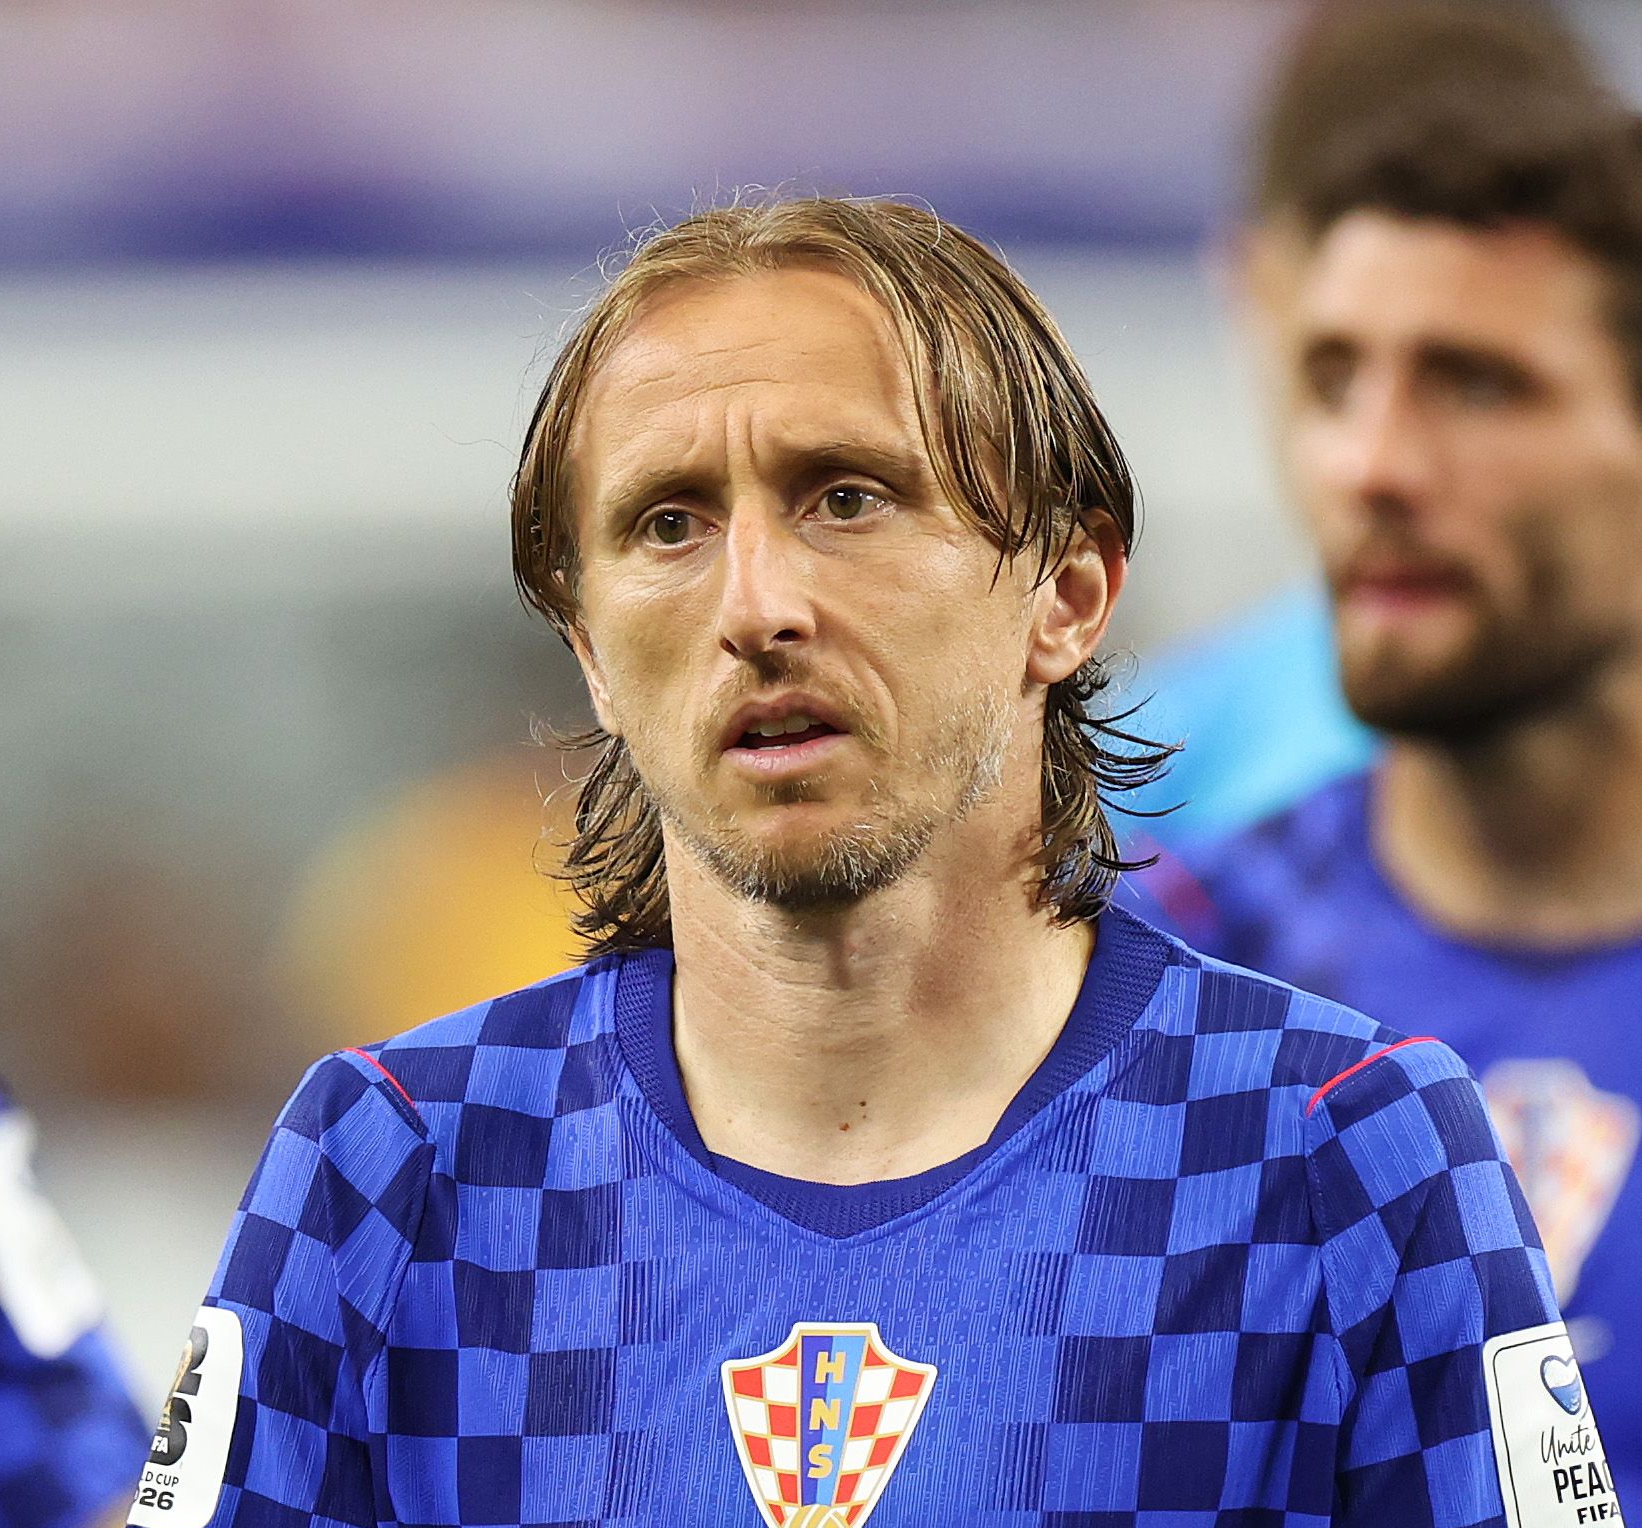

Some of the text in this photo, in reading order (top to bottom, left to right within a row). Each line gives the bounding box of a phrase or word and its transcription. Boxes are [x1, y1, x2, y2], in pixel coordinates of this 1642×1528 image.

[807, 1351, 846, 1480] HNS
[1541, 1424, 1596, 1467] Unite
[155, 1473, 179, 1487] CUP
[135, 1487, 175, 1511] 26
[1576, 1501, 1620, 1525] FIFA
